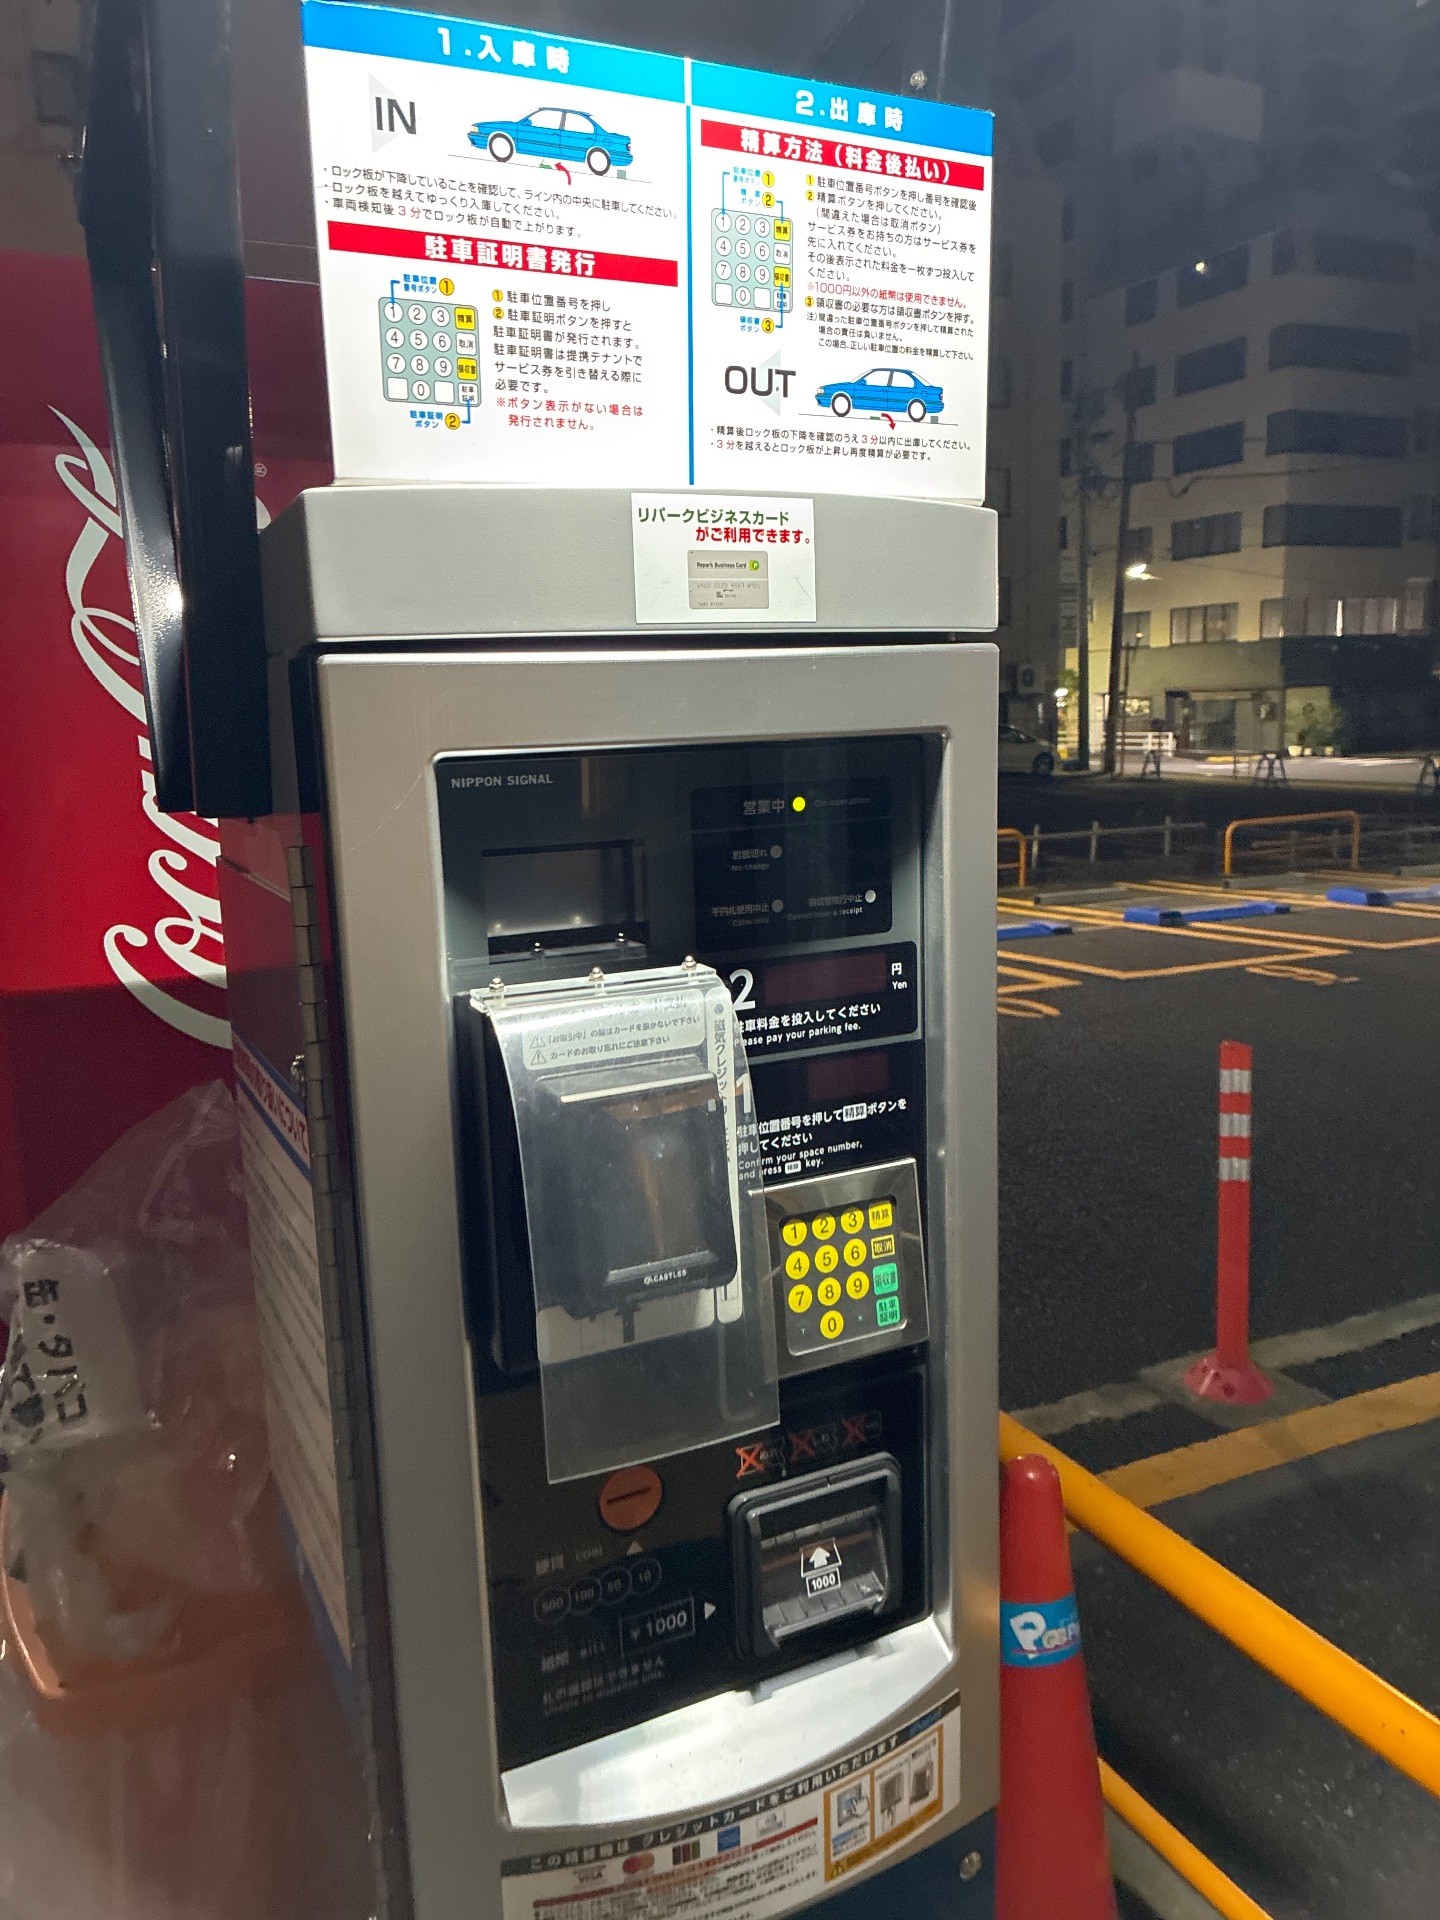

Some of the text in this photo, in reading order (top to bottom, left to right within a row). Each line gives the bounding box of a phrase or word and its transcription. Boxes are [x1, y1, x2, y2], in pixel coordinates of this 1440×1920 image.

[375, 97, 417, 135] IN
[720, 217, 767, 234] 1 2 3
[425, 235, 596, 276] 駐車証明書発行
[719, 240, 767, 257] 4 5 6
[808, 236, 897, 258] 先に入れてください。
[720, 264, 767, 281] 7 8 9
[808, 268, 850, 282] ください。
[507, 290, 611, 312] 駐車位置番号を押し
[739, 289, 748, 302] 0
[389, 306, 445, 323] 1 2 3
[507, 308, 633, 332] 駐車証明ボタンを押すと
[389, 331, 447, 348] 4 5 6
[493, 325, 641, 350] 駐車証明書が発行されます。
[494, 343, 643, 367] 駐車証明書は提携テナントで
[391, 357, 448, 373] 7 8 9
[495, 378, 549, 395] 必要です。
[724, 365, 796, 398] OUT
[416, 384, 426, 398] 0
[508, 413, 596, 431] 発行されません。
[638, 507, 789, 526] リパークビジネスカード
[695, 526, 810, 545] がご利用できます。
[451, 774, 553, 789] NIPPON SIGNAL
[743, 798, 786, 816] 営業中
[891, 962, 902, 976] 円
[730, 969, 756, 1011] 2
[892, 980, 907, 990] Yen
[767, 1033, 782, 1045] pay
[786, 1031, 805, 1040] your
[809, 1025, 842, 1039] parking
[845, 1022, 861, 1032] fee.
[736, 1074, 751, 1114] 1
[777, 1153, 796, 1166] your
[800, 1148, 825, 1163] space
[828, 1141, 863, 1154] number.
[805, 1159, 824, 1169] key.
[739, 1170, 755, 1181] and
[791, 1213, 857, 1239] 1 2 3
[793, 1246, 859, 1272] 4 5 6
[654, 1269, 687, 1283] CASTLES
[796, 1278, 863, 1306] 7 8 9
[827, 1317, 837, 1332] 0
[811, 1573, 836, 1590] 1000
